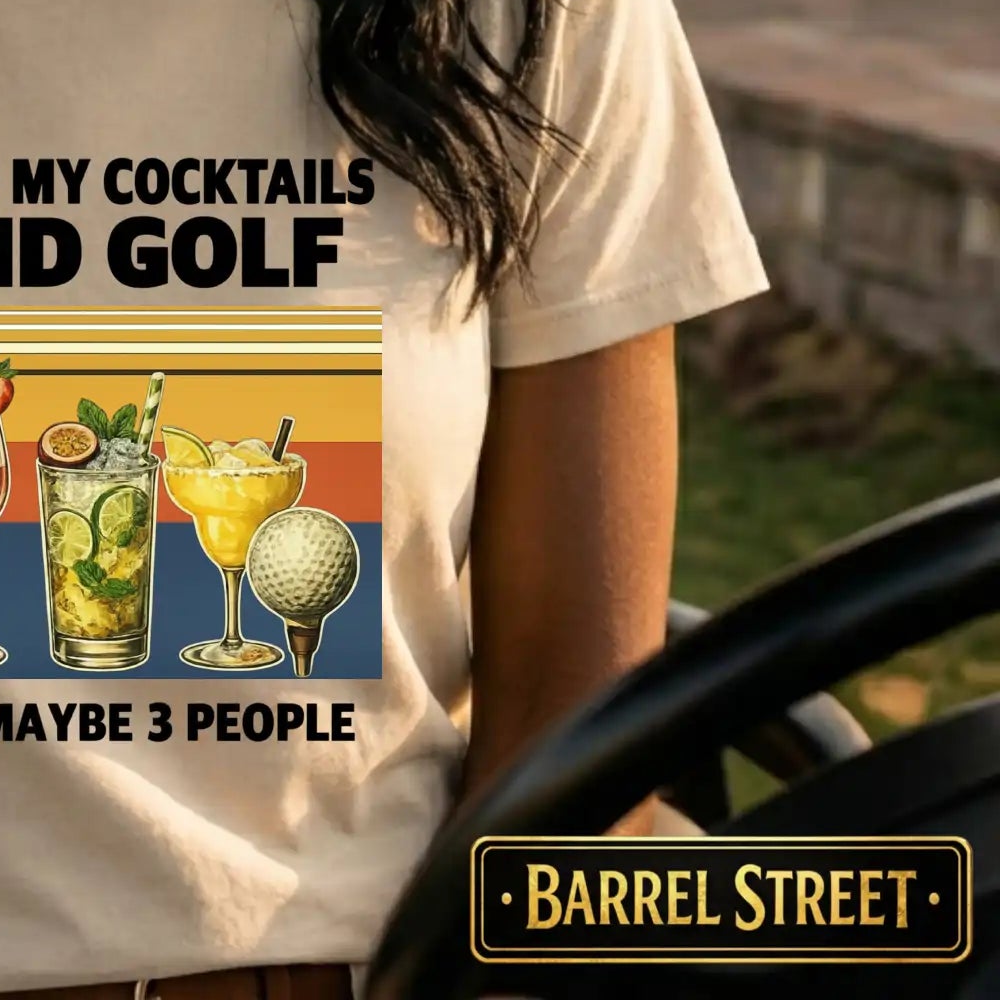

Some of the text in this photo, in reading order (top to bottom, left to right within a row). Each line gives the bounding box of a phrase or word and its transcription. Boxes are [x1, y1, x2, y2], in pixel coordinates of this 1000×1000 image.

[12, 158, 91, 205] MY
[103, 157, 375, 206] COCKTAILS
[107, 215, 344, 289] GOLF
[147, 701, 173, 743] 3
[187, 702, 356, 743] PEOPLE
